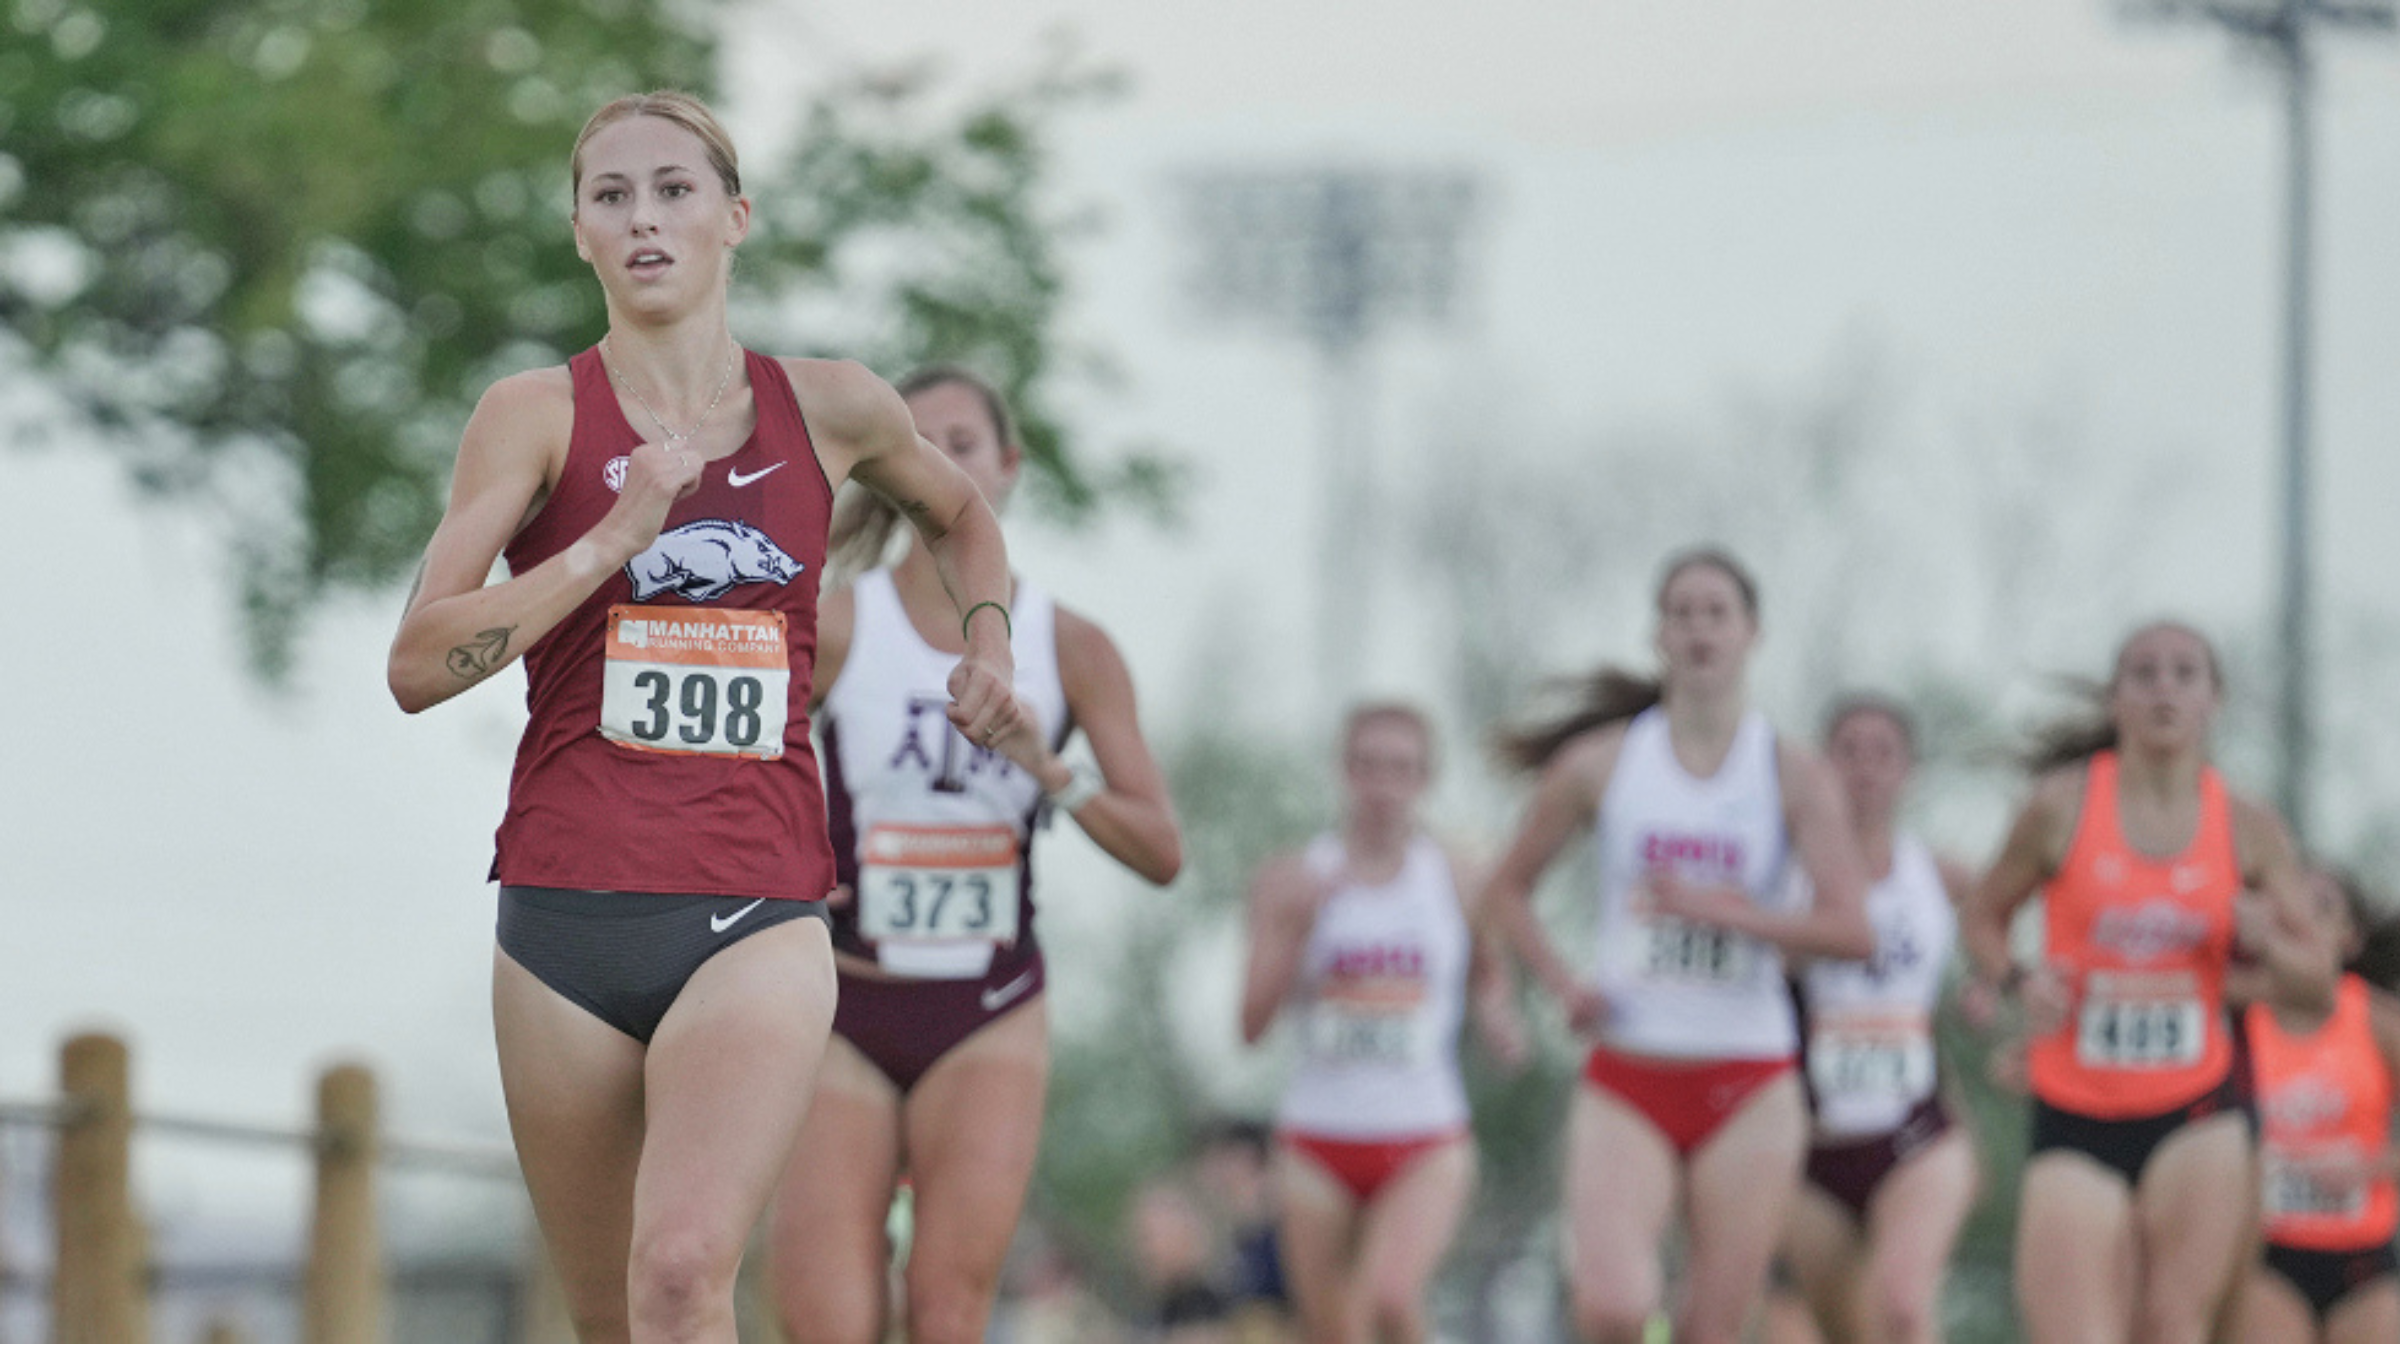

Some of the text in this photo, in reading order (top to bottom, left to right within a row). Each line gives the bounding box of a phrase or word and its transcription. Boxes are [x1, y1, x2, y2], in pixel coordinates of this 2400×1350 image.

[649, 620, 779, 642] MANHATTAN
[650, 637, 713, 651] RUNNING
[631, 670, 763, 747] 398
[887, 872, 992, 930] 373
